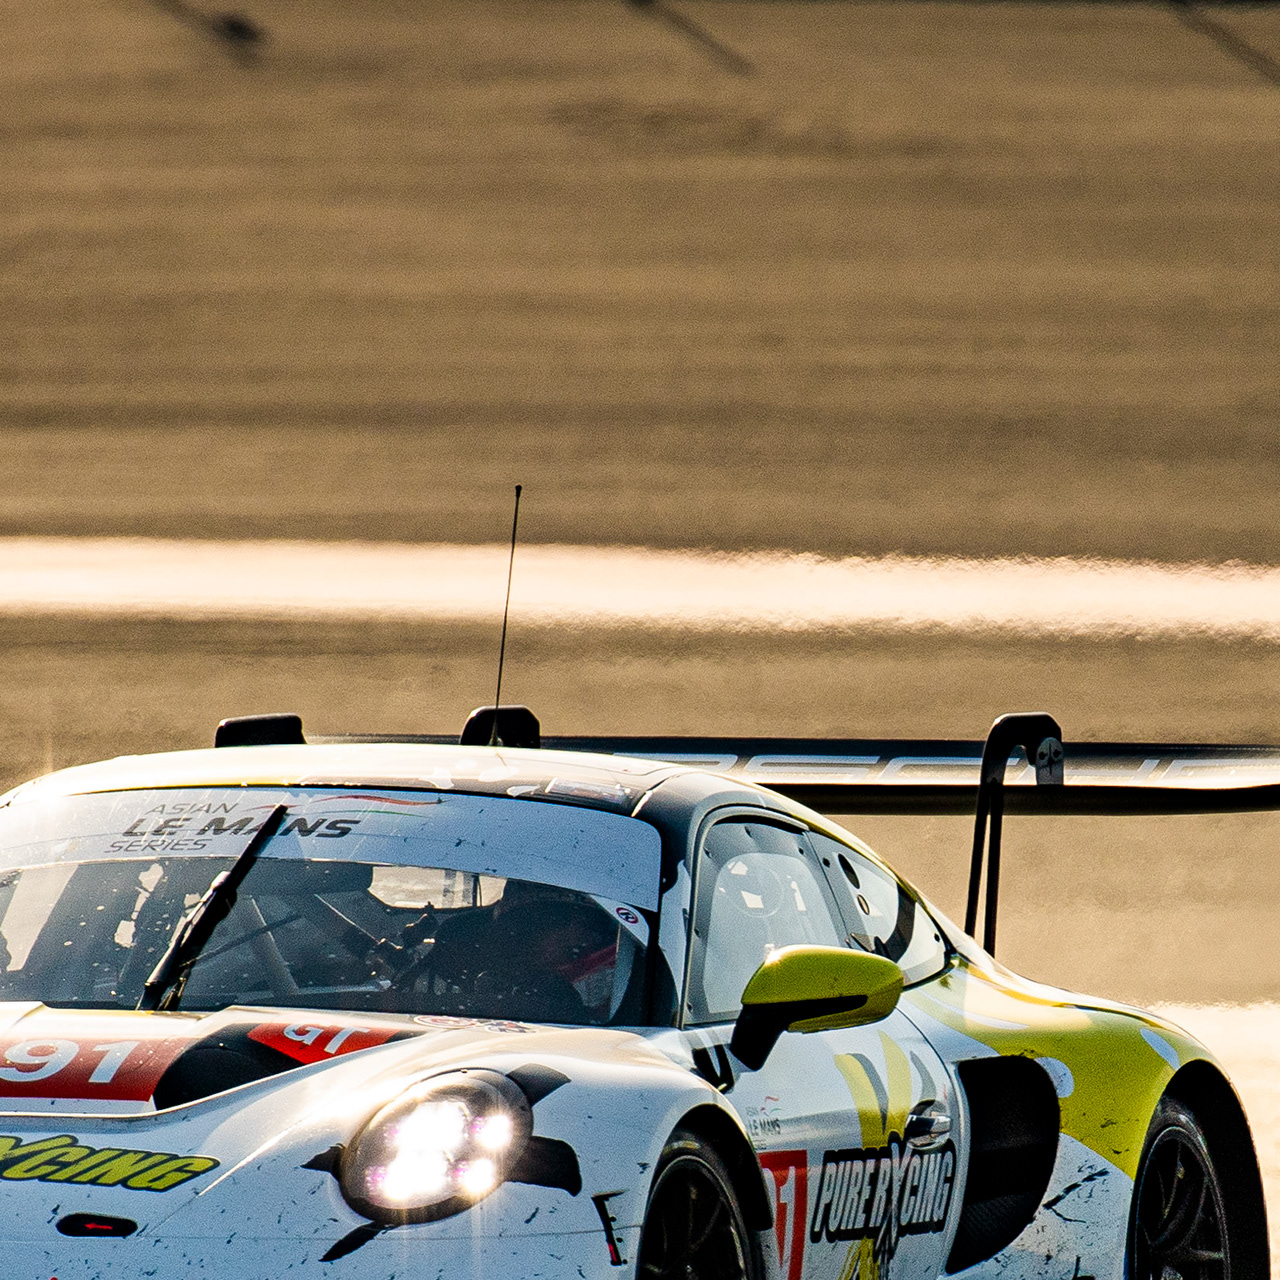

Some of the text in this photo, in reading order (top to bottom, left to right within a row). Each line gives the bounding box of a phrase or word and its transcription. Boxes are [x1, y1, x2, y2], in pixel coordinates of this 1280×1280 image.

[145, 803, 238, 815] ASIAN
[123, 818, 191, 836] LE
[106, 838, 212, 853] SERIES
[282, 1023, 371, 1054] GT
